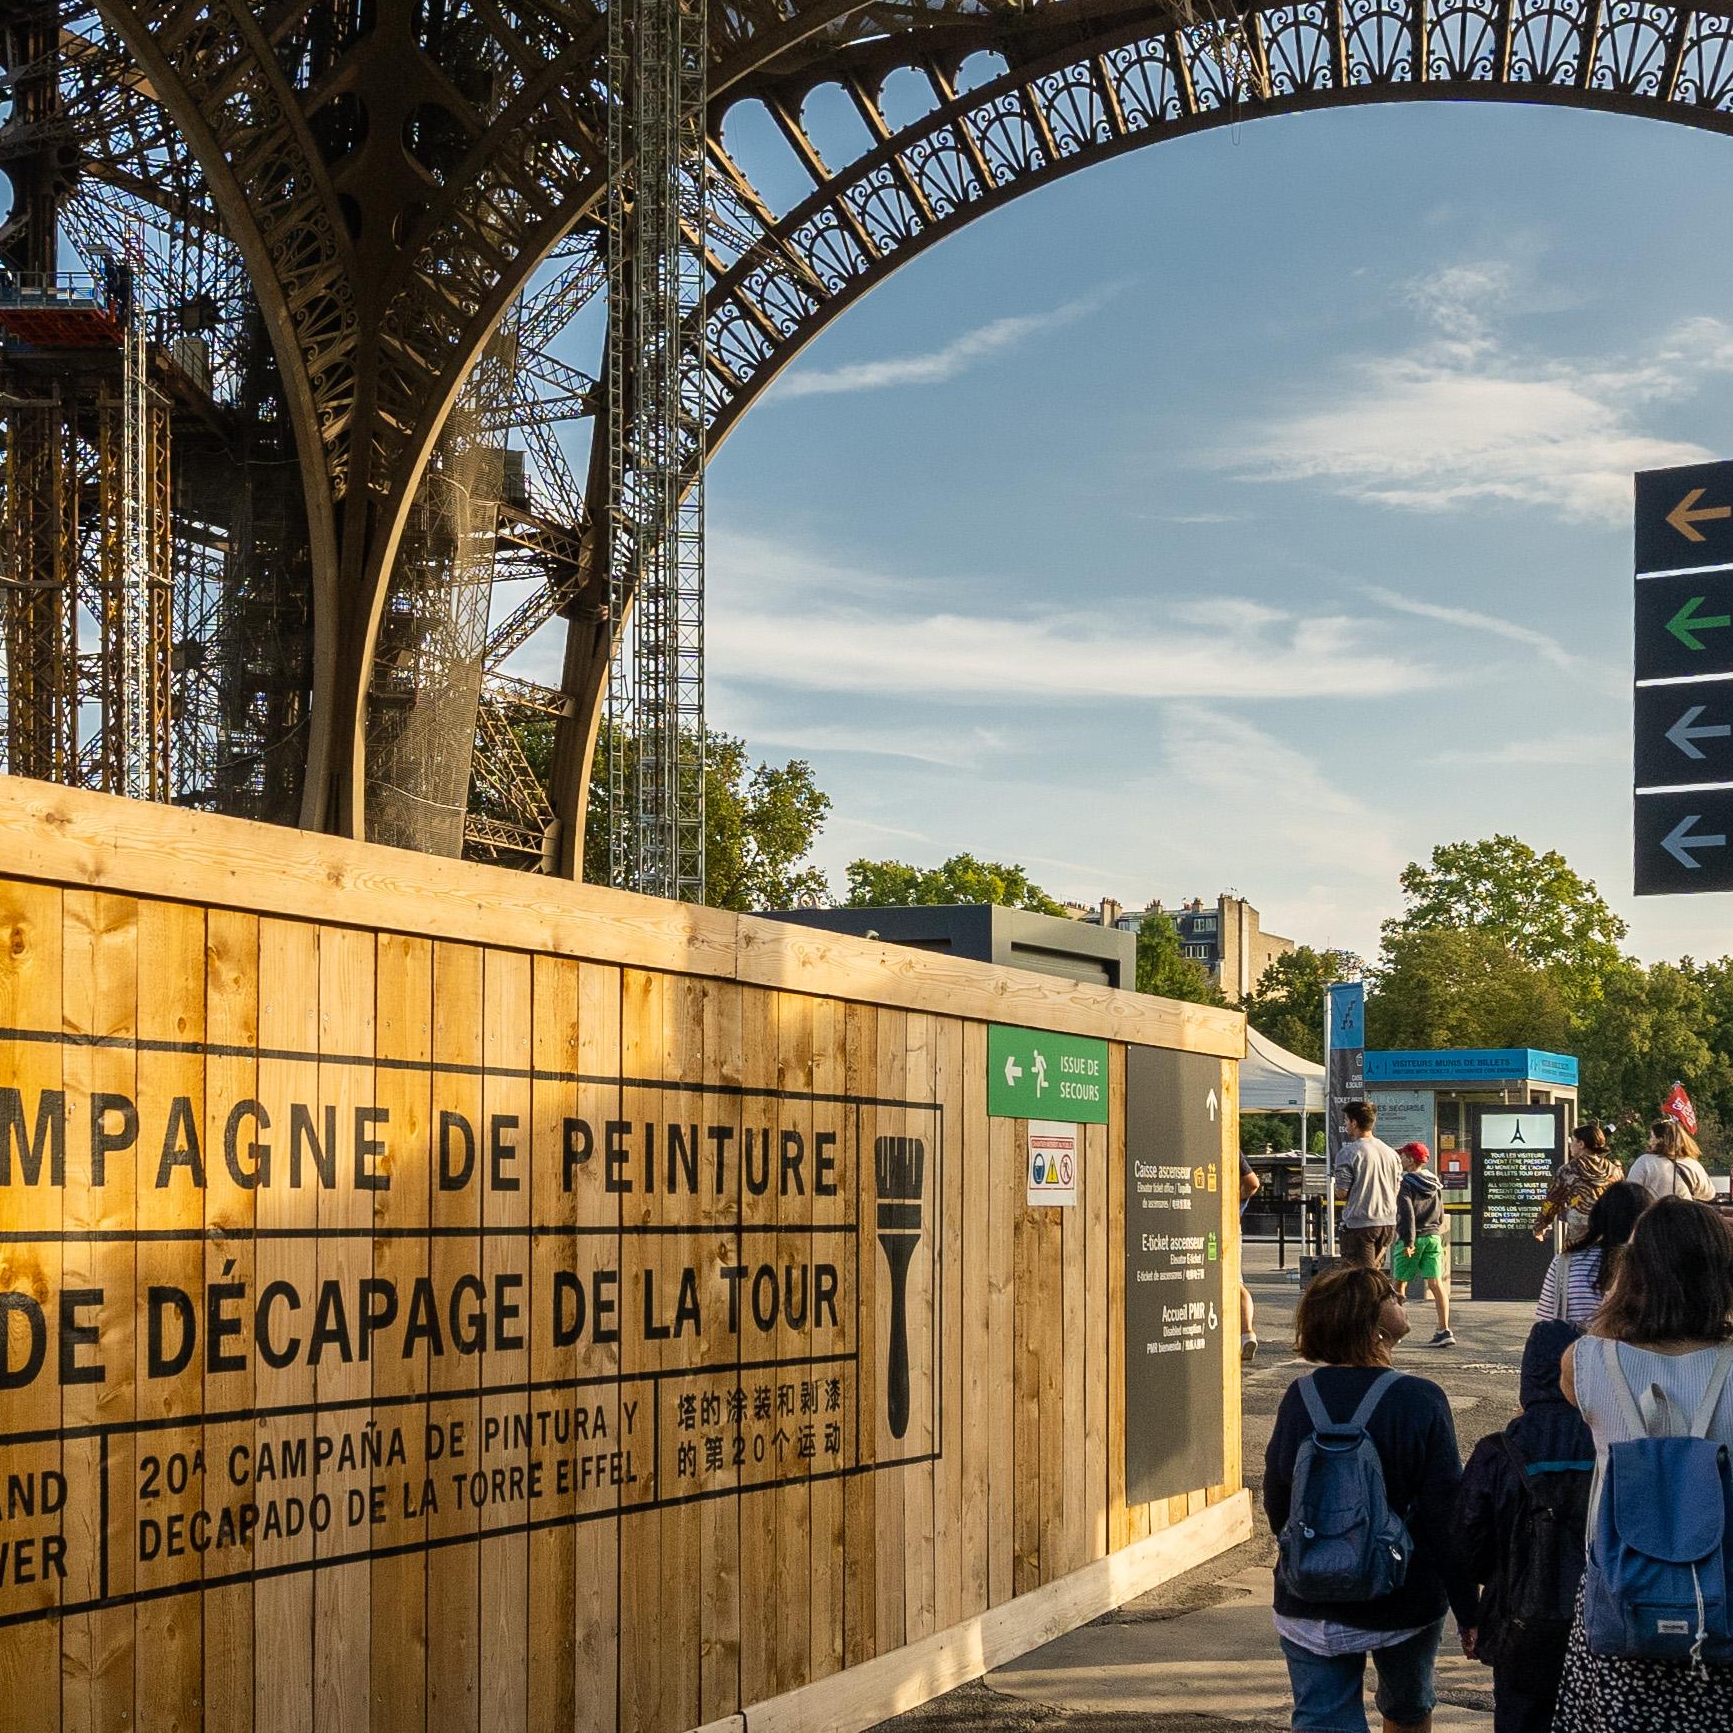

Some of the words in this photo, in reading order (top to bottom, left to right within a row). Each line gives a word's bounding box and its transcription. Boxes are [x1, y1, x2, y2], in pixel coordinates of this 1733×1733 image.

[1060, 1055, 1085, 1074] ISSUE
[1087, 1060, 1099, 1076] DE
[1392, 1059, 1432, 1068] VISITEURS
[1464, 1058, 1476, 1067] DE
[1477, 1057, 1511, 1067] BILLETS
[1059, 1081, 1100, 1102] SECOURS
[438, 1113, 521, 1195] DE
[562, 1115, 841, 1201] PEINTURE
[1134, 1159, 1158, 1179] Caisse
[1158, 1164, 1192, 1180] ascenseur
[1142, 1233, 1169, 1251] E-ticket
[1170, 1236, 1205, 1250] ascenseur
[145, 1257, 526, 1378] DÉCAPAGE
[552, 1269, 617, 1348] DE
[642, 1267, 703, 1342] LA
[718, 1262, 841, 1337] TOUR
[1162, 1303, 1187, 1323] Accueil
[1188, 1301, 1205, 1320] PMR
[678, 1377, 841, 1432] 塔的涂装和剥漆
[227, 1419, 409, 1490] CAMPAÑA
[425, 1418, 468, 1462] DE
[484, 1402, 610, 1454] PINTURA
[623, 1399, 640, 1440] Y
[137, 1496, 333, 1567] DECAPADO
[345, 1486, 387, 1530] DE
[400, 1475, 443, 1521] LA
[454, 1458, 543, 1516] TORRE
[555, 1445, 640, 1501] EIFFEL
